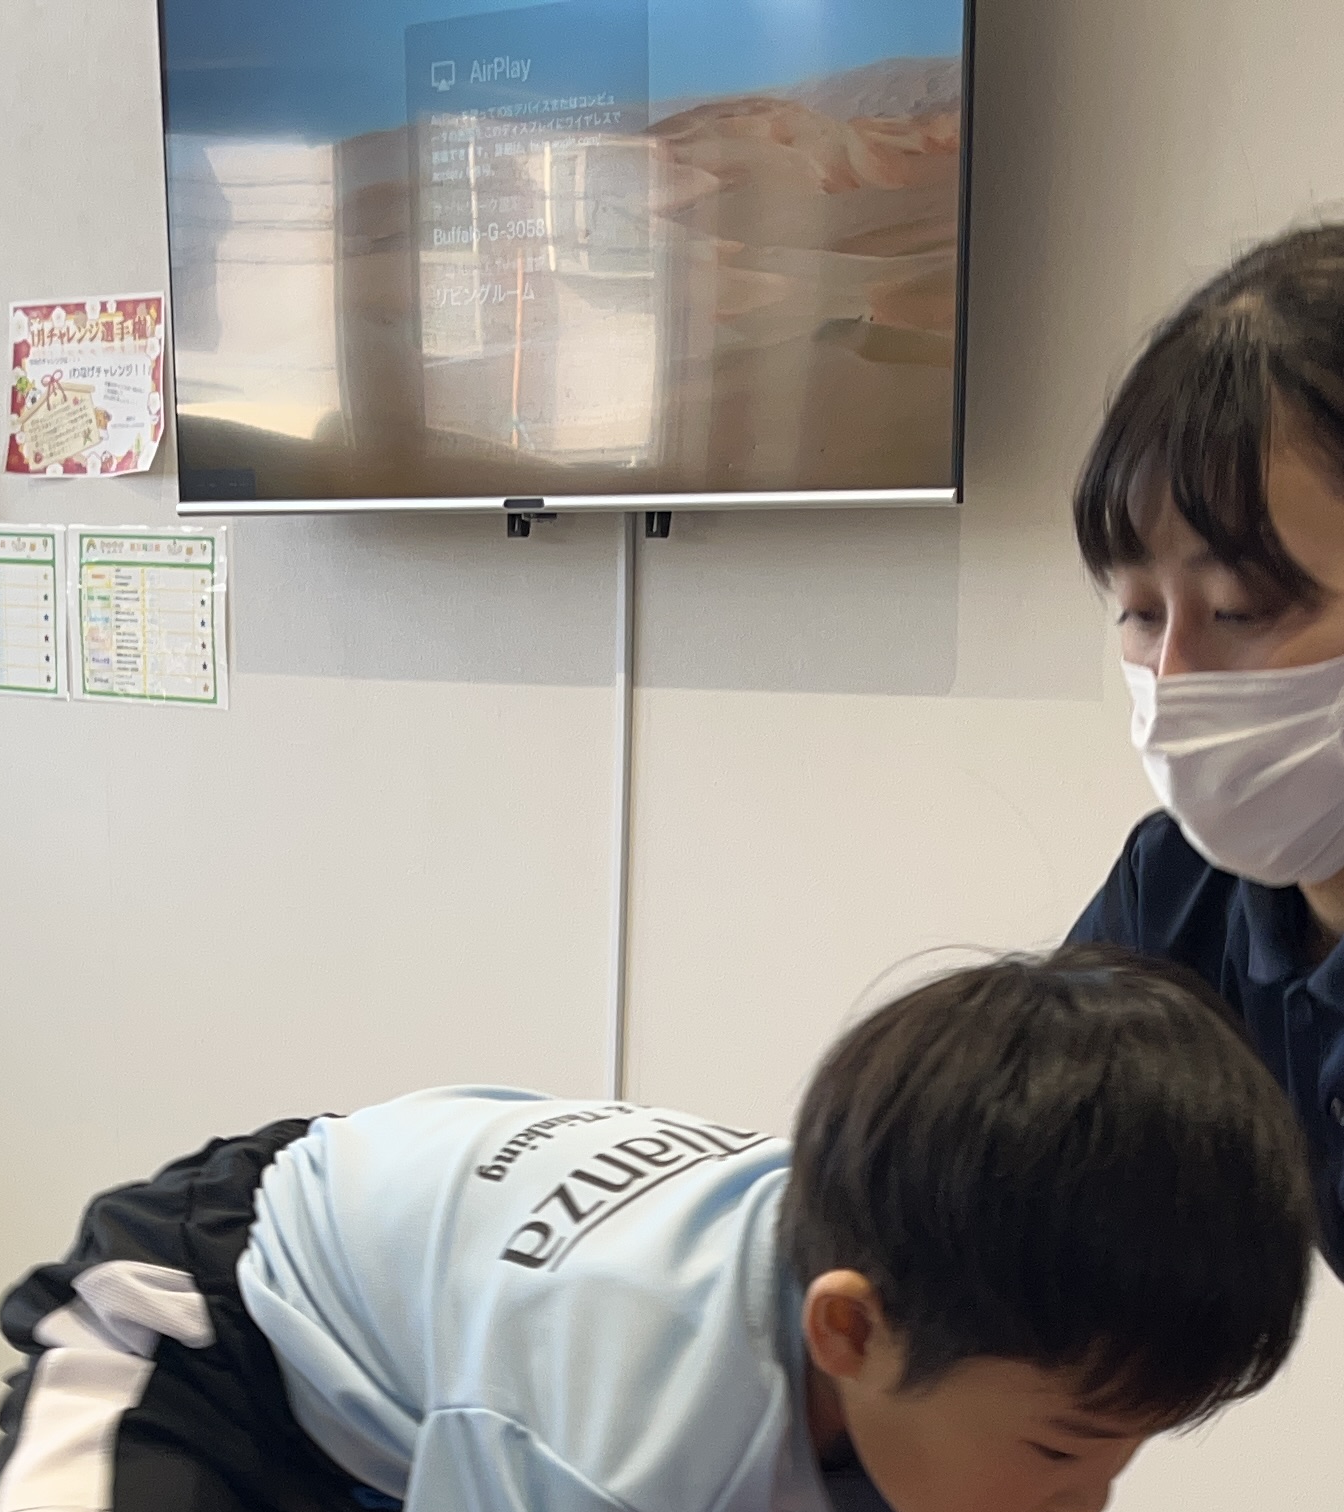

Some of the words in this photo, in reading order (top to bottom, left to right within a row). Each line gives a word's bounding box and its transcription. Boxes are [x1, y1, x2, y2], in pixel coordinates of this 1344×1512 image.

[470, 55, 531, 84] AirPlay
[433, 217, 546, 246] Buffalo-G-3058
[435, 281, 536, 308] リビングルーム
